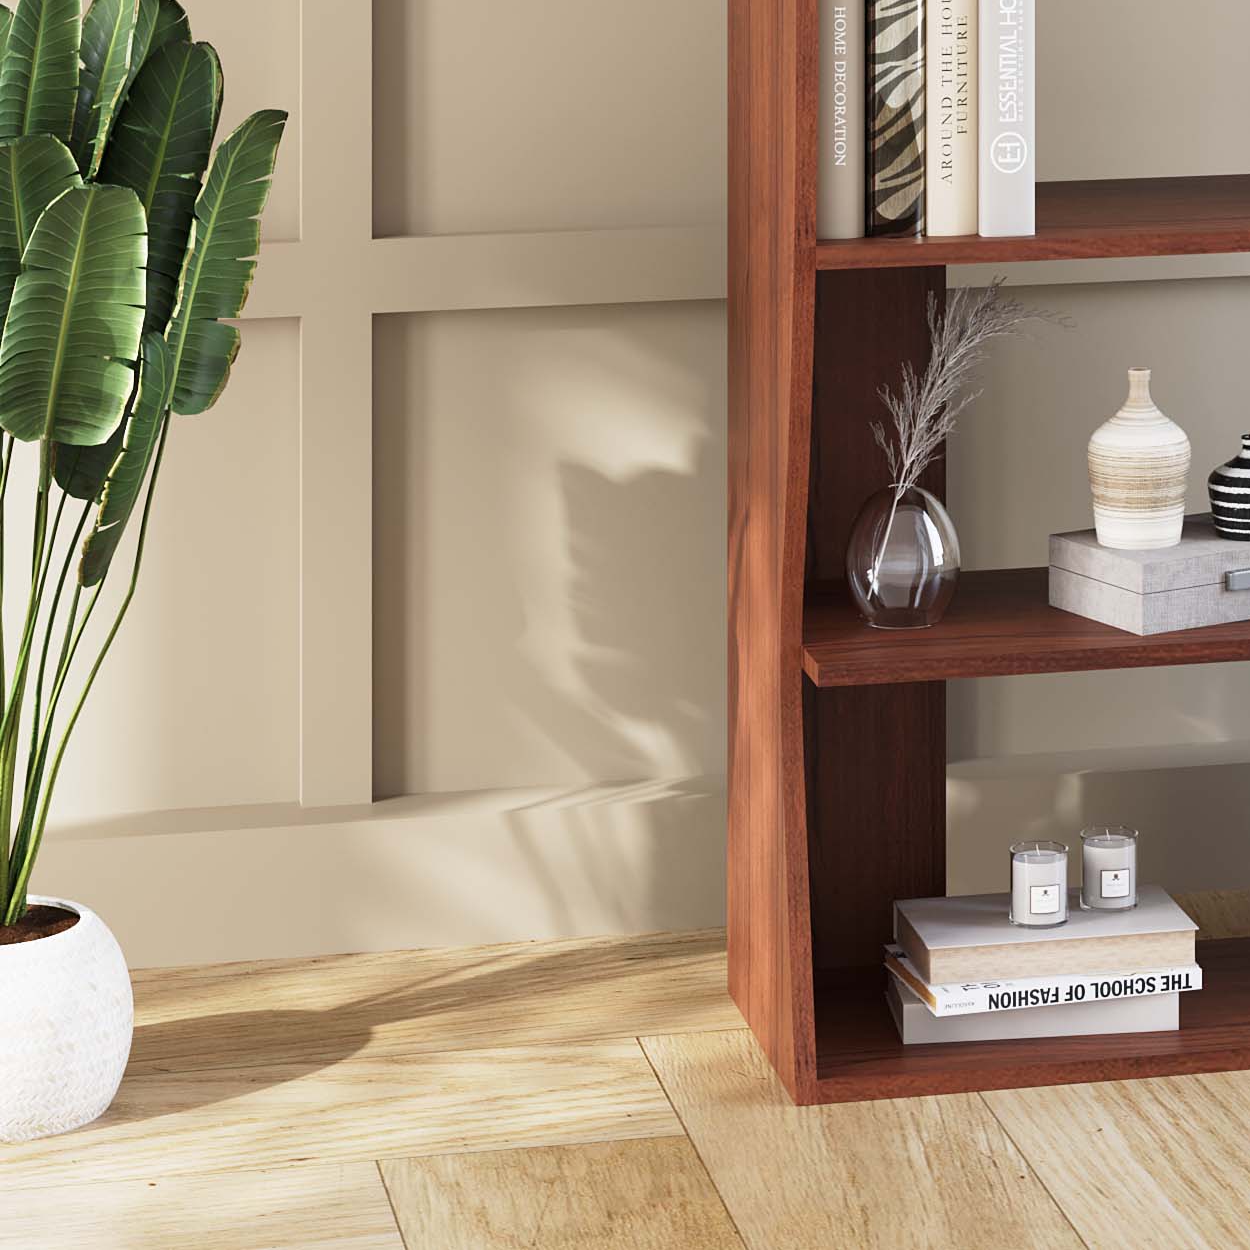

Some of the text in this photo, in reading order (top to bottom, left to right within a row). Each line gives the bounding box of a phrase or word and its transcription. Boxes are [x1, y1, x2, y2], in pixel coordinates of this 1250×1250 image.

[834, 6, 847, 167] HOME DECORATION
[940, 46, 954, 87] THE
[956, 15, 969, 135] FURNITURE
[999, 29, 1018, 122] ESSENTIAL
[940, 96, 954, 184] AROUND
[988, 973, 1192, 1010] THE SCHOOL OF FASHION
